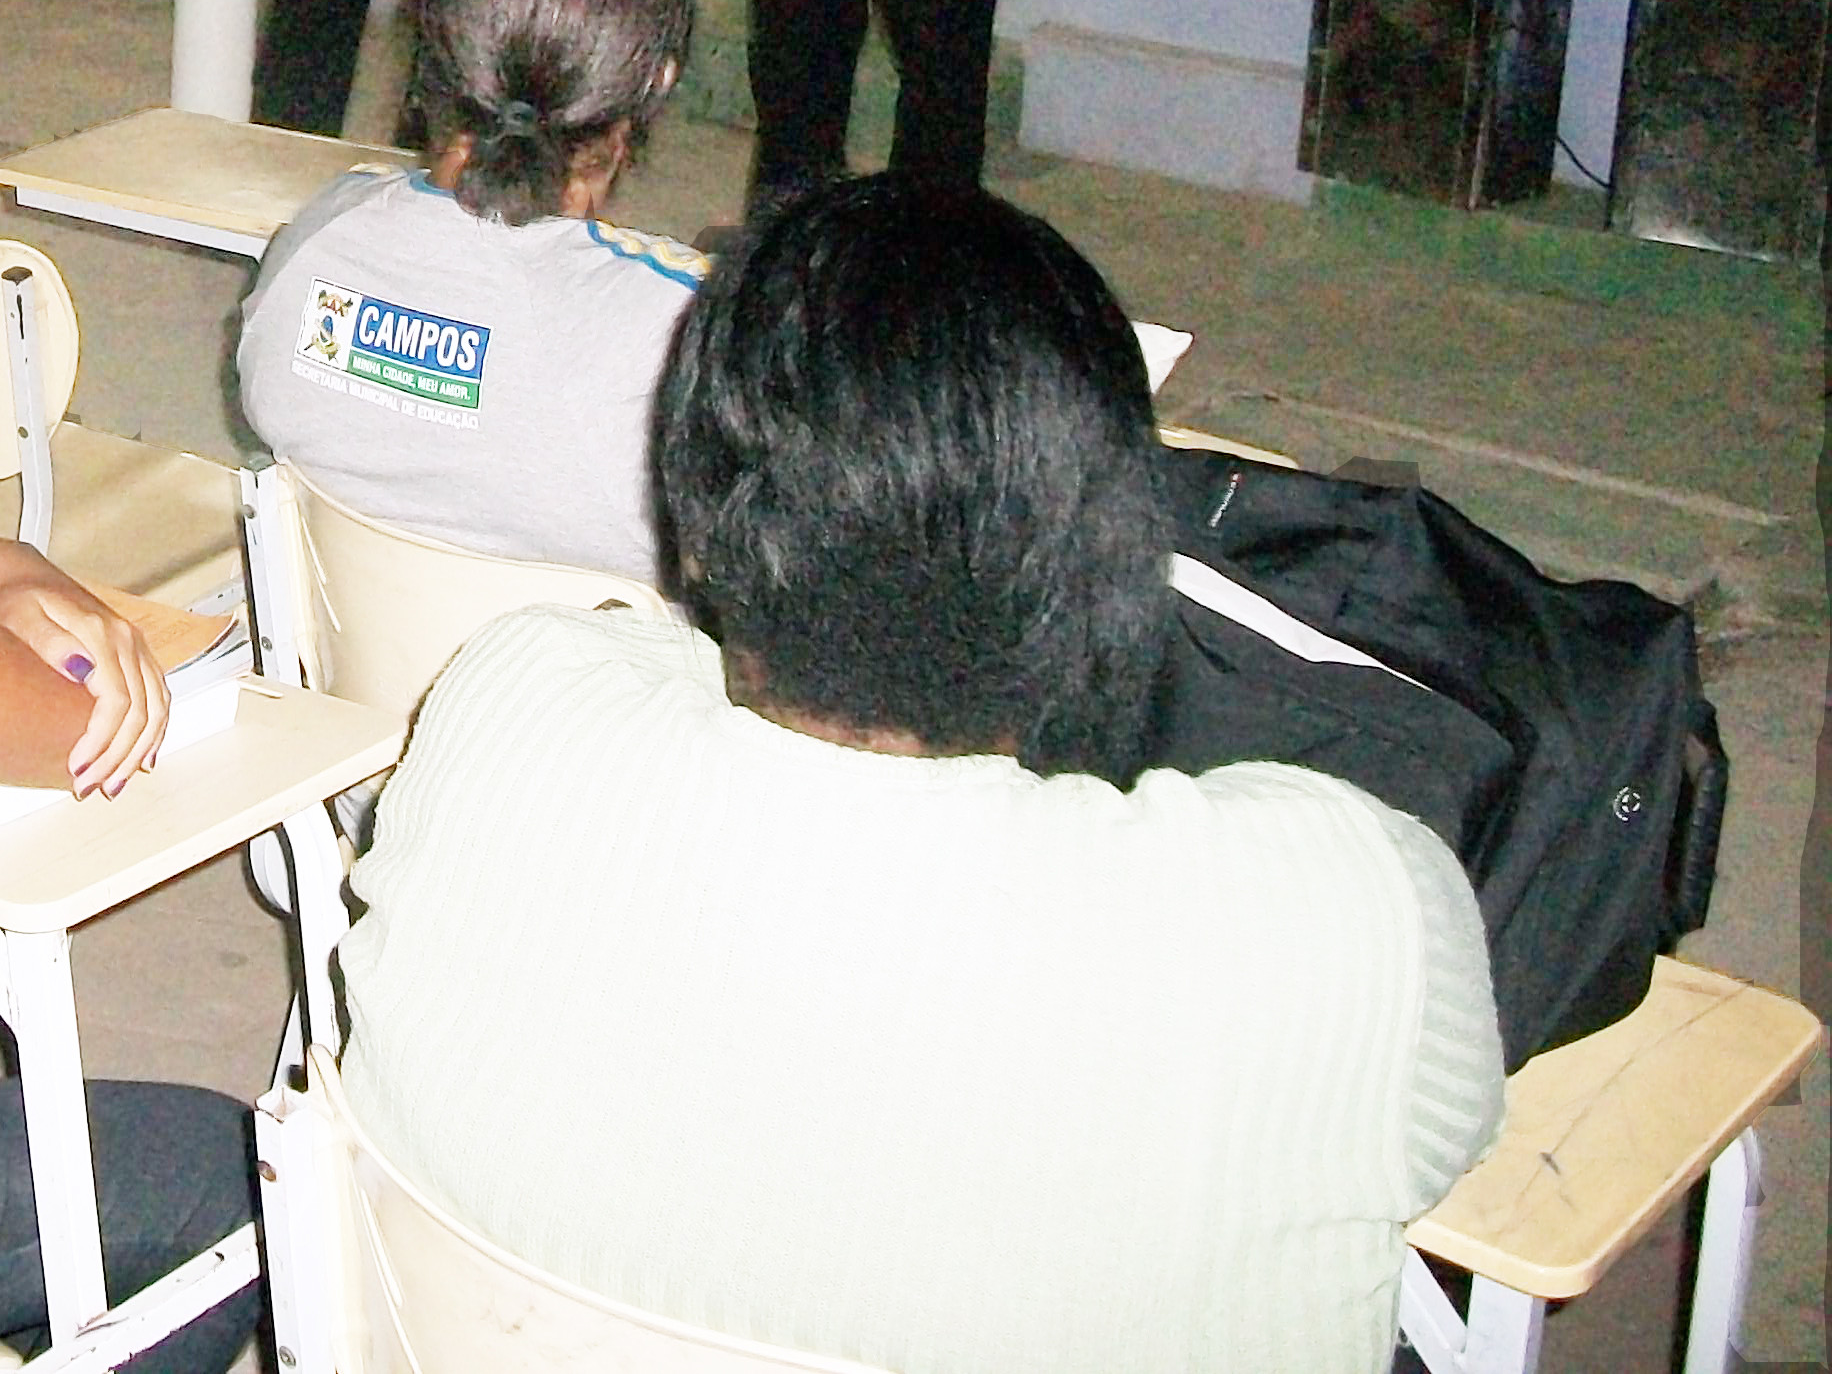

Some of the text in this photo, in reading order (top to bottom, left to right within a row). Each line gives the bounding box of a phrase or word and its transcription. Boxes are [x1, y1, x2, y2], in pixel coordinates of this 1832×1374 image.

[358, 305, 480, 372] CAMPOS
[291, 359, 480, 430] SECRETARIA MUNICIPAL DE EDUCAÇÃO
[352, 356, 471, 400] MINHA CIDADE, MEU AMOR.
